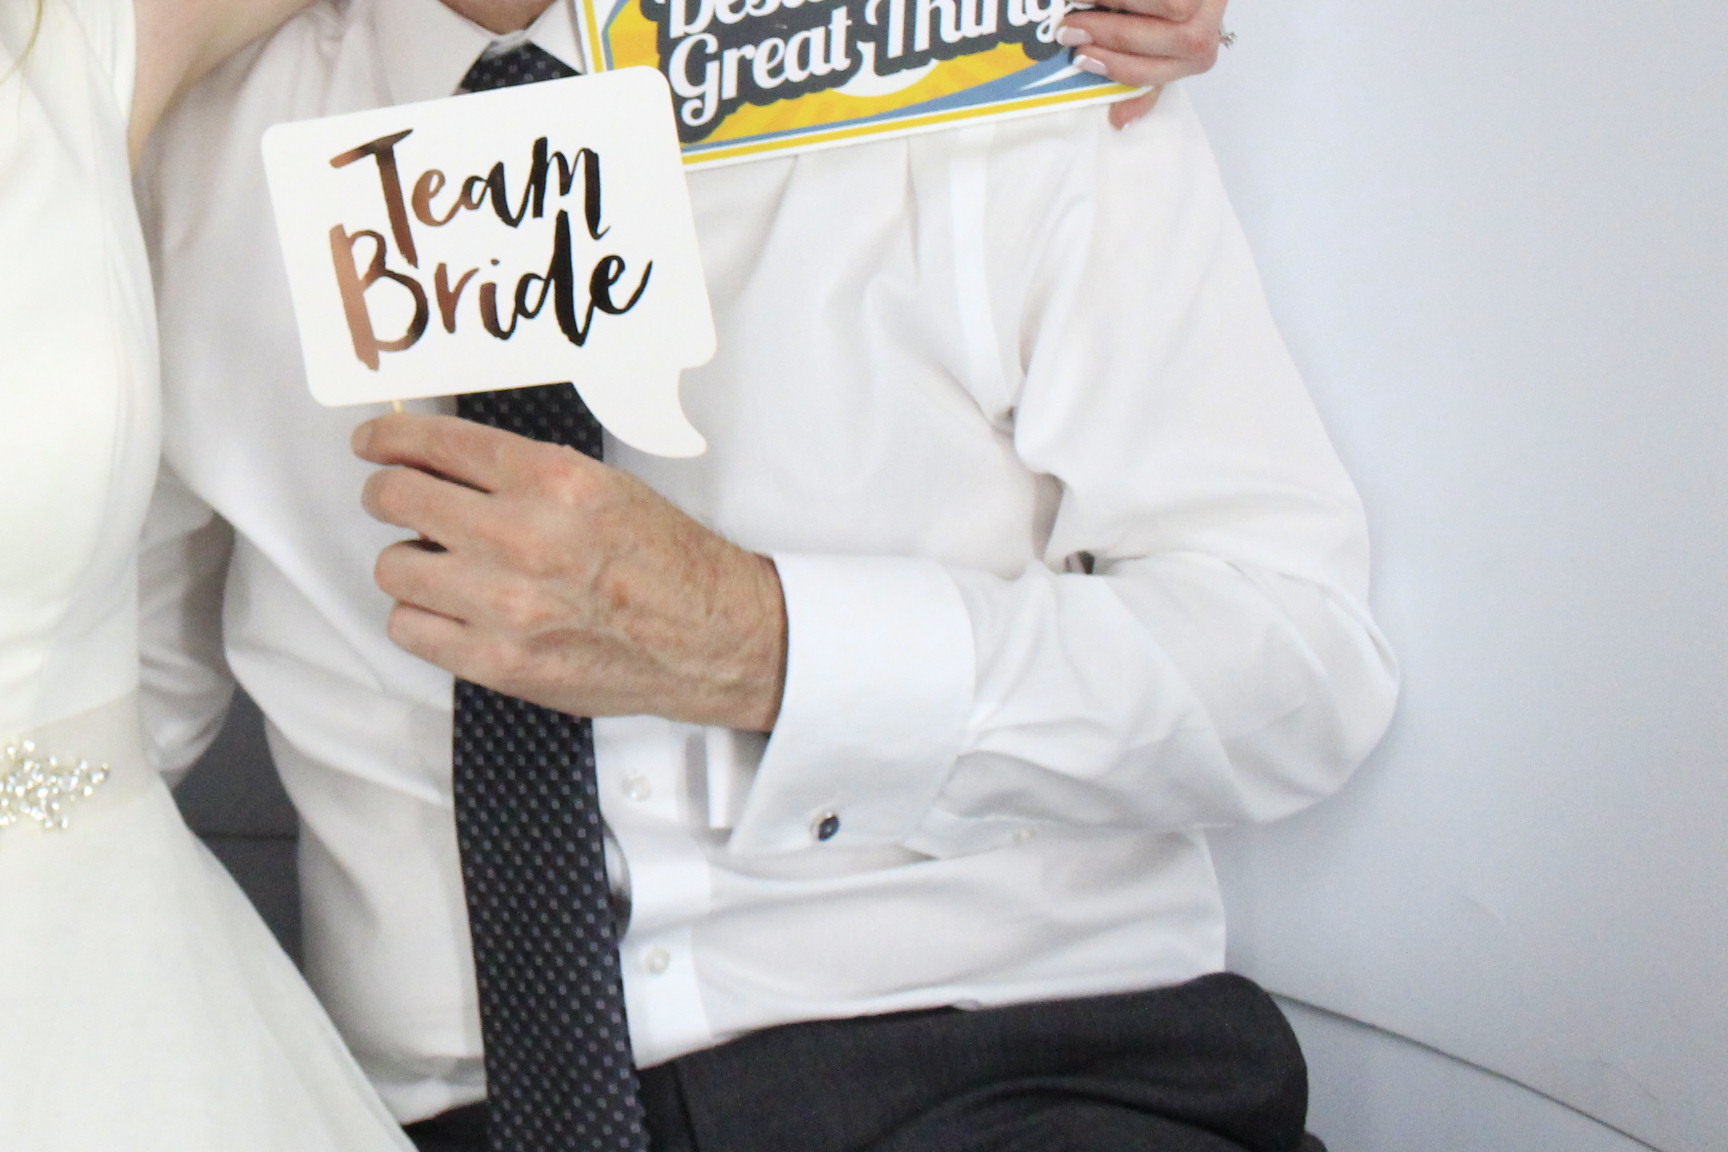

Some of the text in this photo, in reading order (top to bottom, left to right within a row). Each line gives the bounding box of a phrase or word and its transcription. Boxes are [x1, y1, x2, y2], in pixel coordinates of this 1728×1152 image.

[668, 19, 853, 127] Great
[329, 128, 611, 269] Team
[329, 209, 653, 372] Bride
